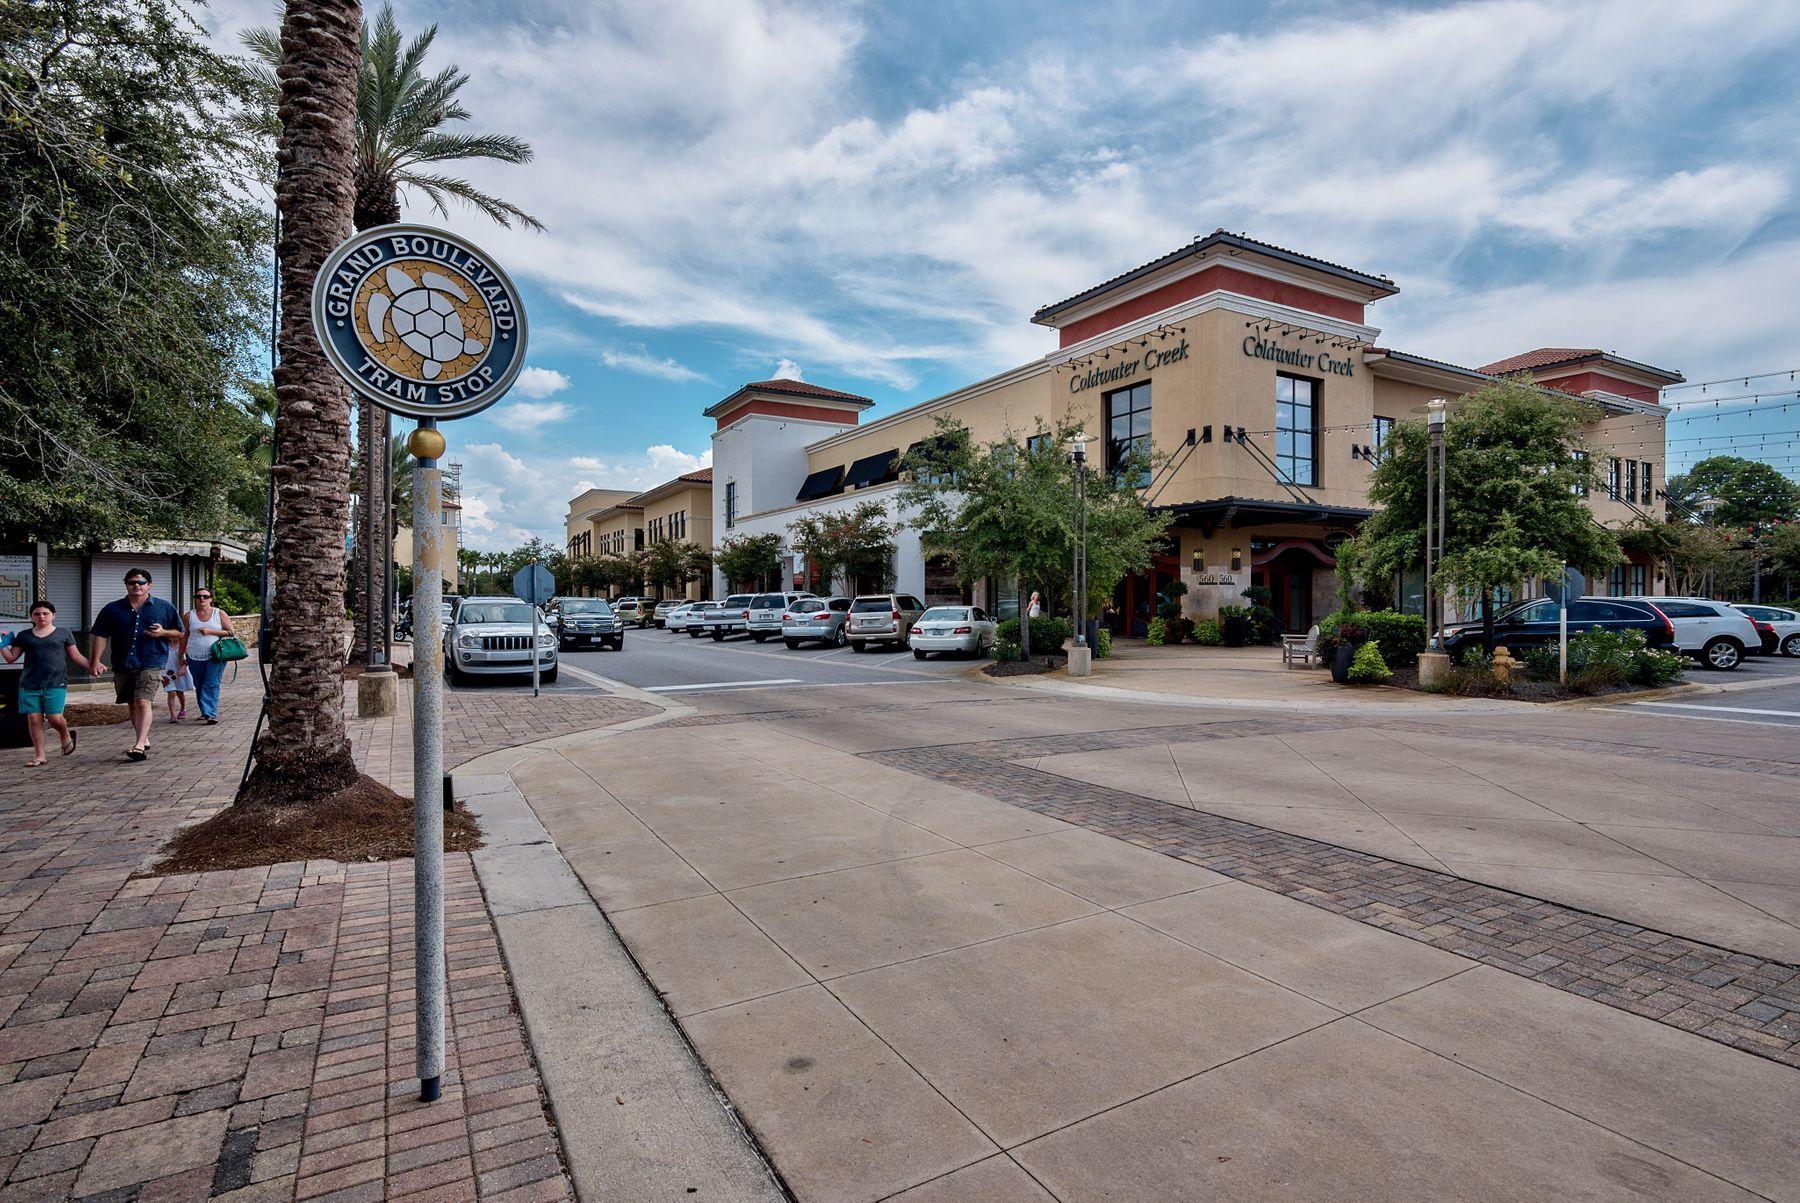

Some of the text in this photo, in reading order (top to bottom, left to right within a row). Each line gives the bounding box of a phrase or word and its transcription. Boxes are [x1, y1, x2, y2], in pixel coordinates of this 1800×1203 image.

[328, 237, 514, 331] GRAND BOULEVARD
[356, 356, 494, 402] TRAM STOP
[1070, 338, 1190, 393] Coldwater Creek
[1243, 336, 1355, 377] Coldwater Creek
